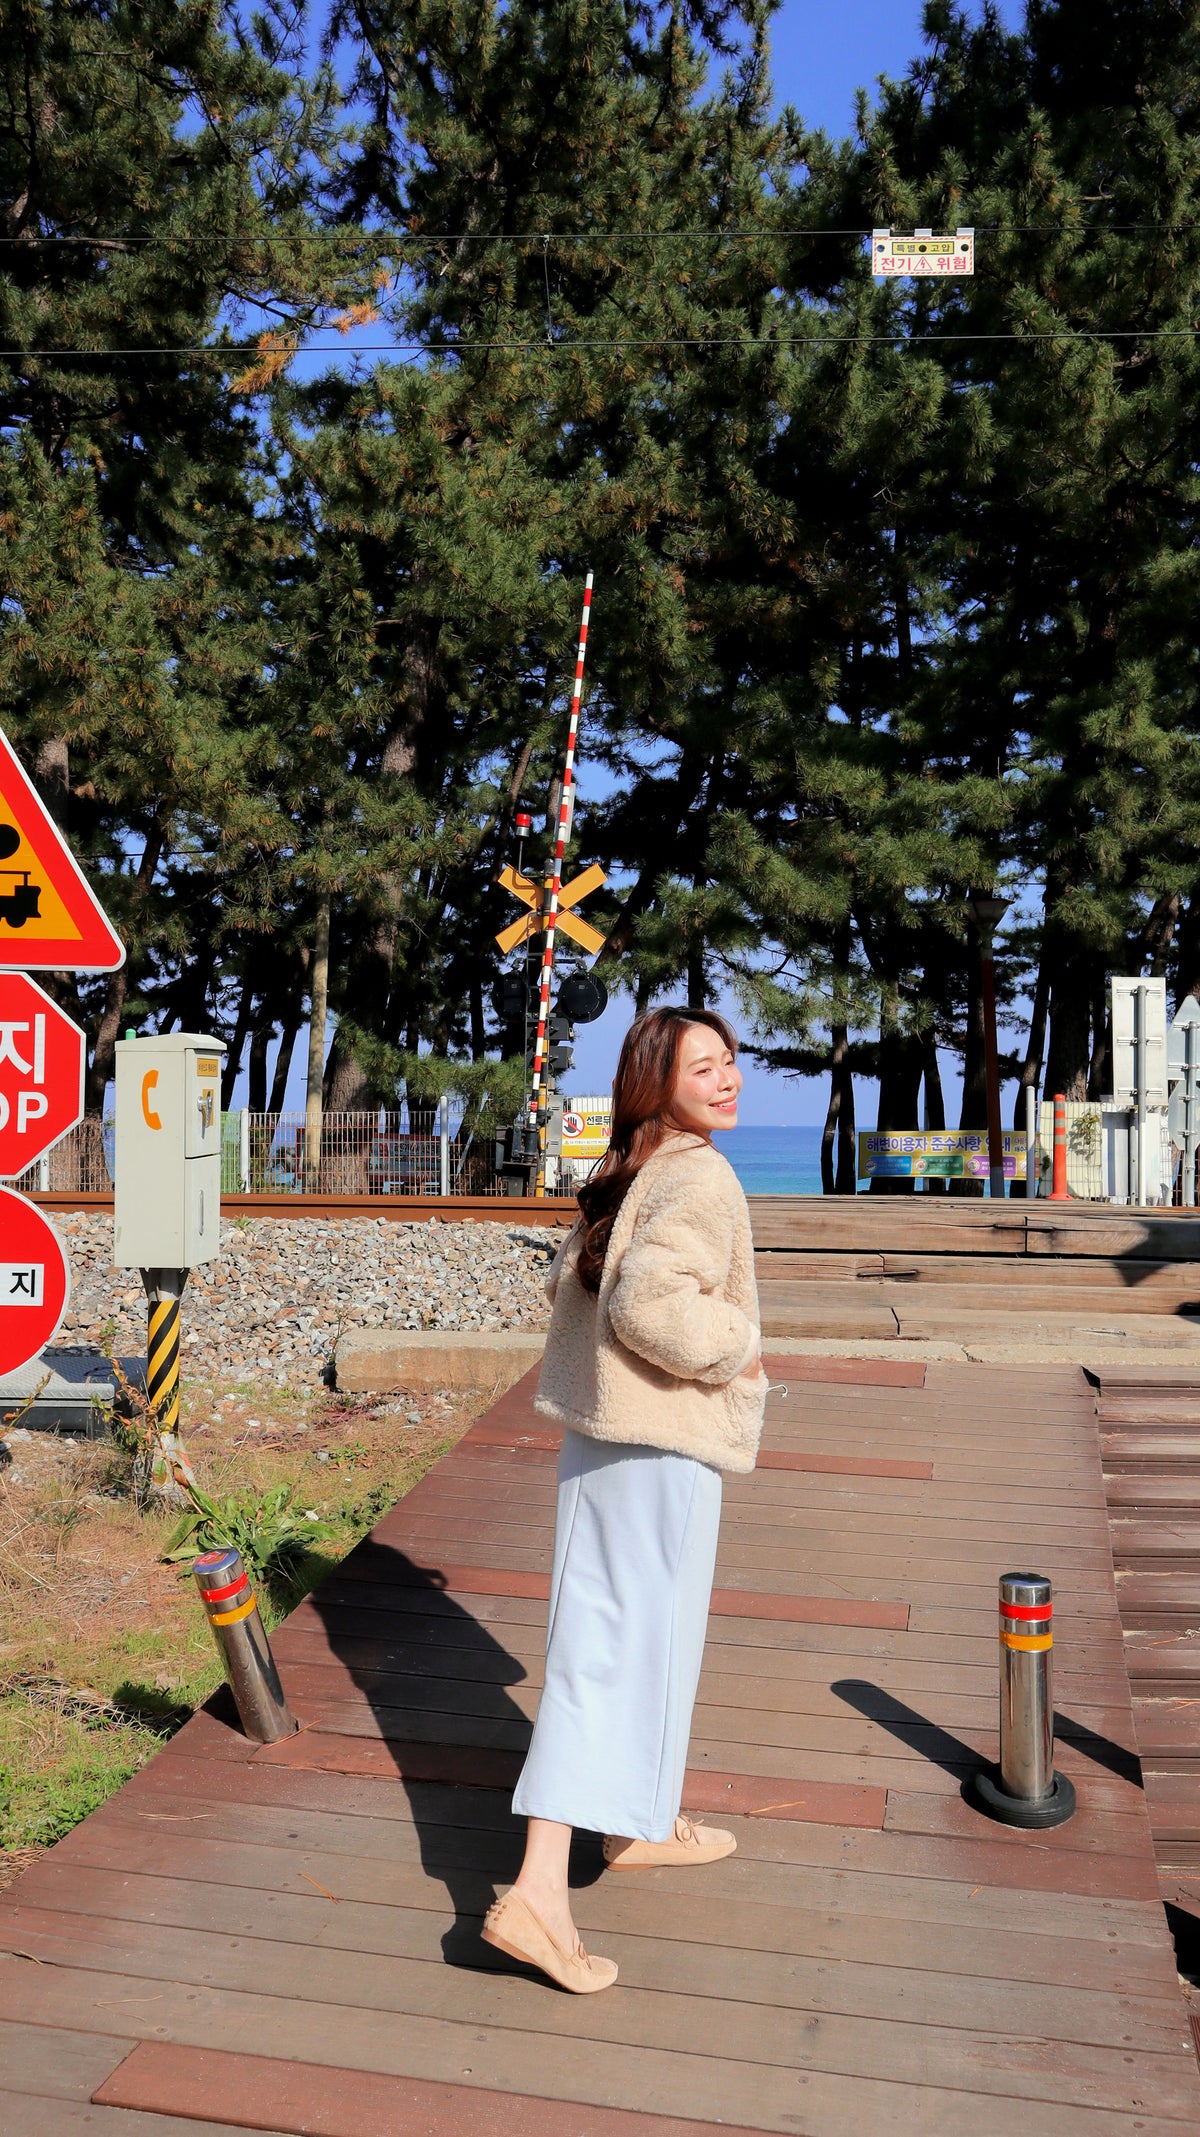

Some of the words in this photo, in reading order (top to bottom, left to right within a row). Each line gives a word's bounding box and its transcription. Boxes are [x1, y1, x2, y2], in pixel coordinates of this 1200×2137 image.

[896, 244, 916, 253] 특별
[930, 244, 951, 253] 고압
[881, 257, 911, 271] 전기
[937, 256, 967, 270] 위험
[0, 1013, 46, 1084] 지
[866, 1136, 927, 1152] 해변이용자
[931, 1136, 982, 1152] 준수사항
[9, 1269, 36, 1297] 지
